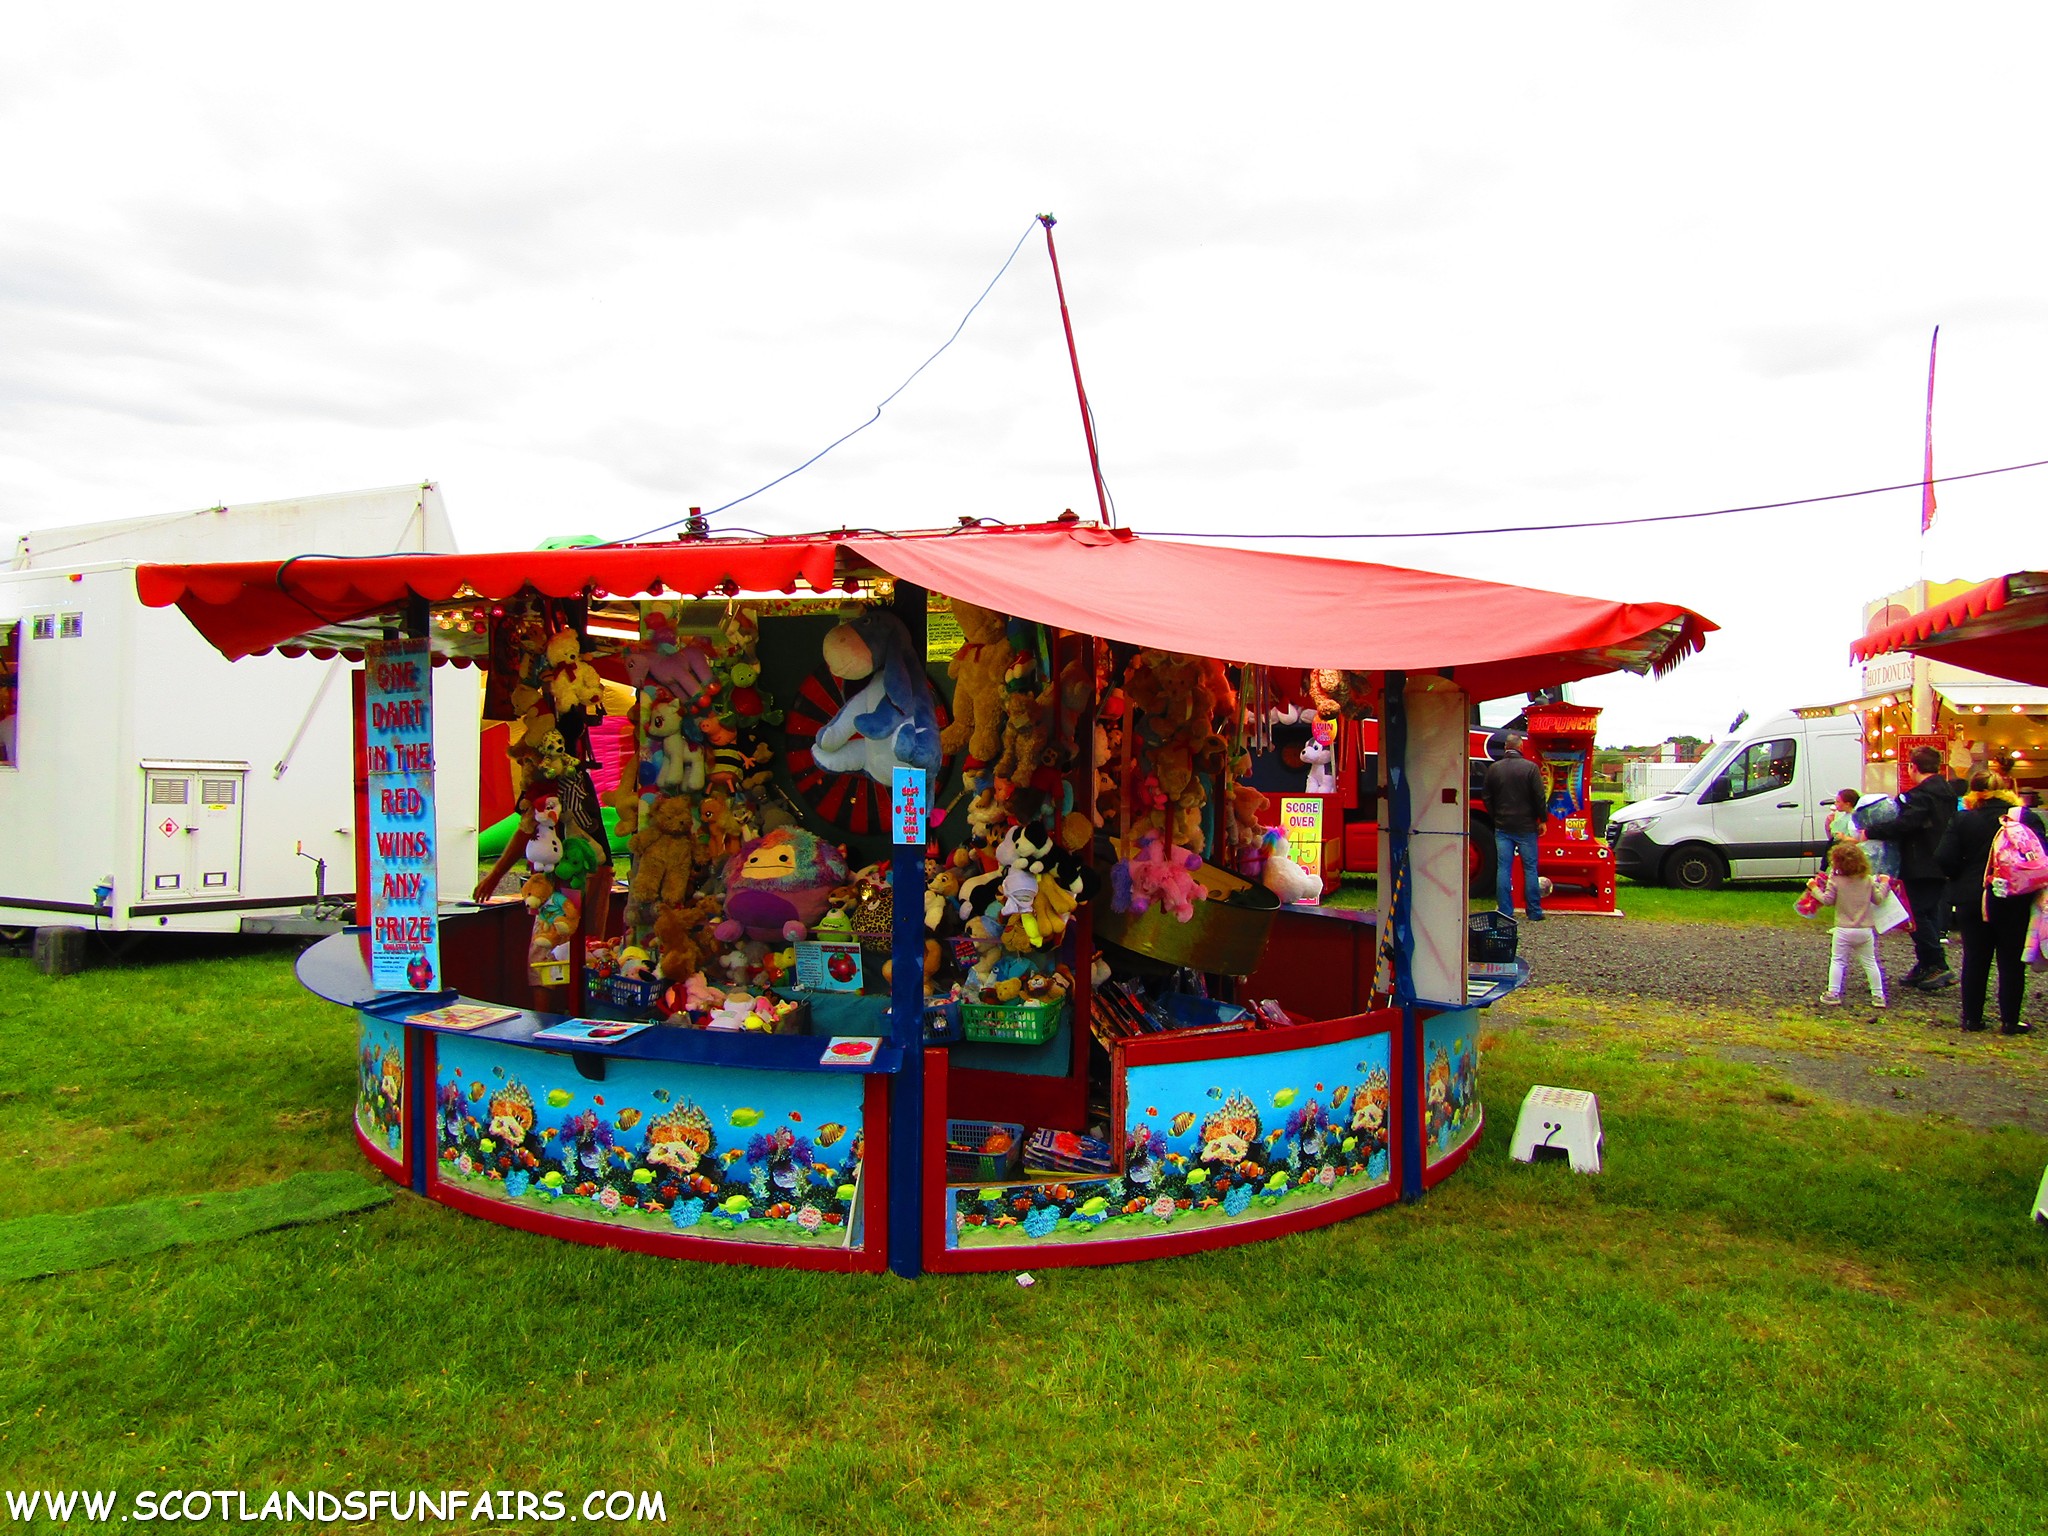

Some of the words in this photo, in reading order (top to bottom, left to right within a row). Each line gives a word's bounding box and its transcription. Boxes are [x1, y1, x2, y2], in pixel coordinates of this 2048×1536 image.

[377, 660, 415, 690] ONE
[1867, 668, 1882, 686] HOT
[1883, 661, 1911, 683] DONUTS
[372, 698, 424, 730] DART
[1316, 723, 1333, 731] WIN
[367, 744, 389, 771] IN
[393, 742, 431, 770] THE
[381, 788, 421, 815] RED
[1285, 802, 1319, 813] SCORE
[1289, 816, 1315, 827] OVER
[1567, 819, 1587, 829] ONLY
[376, 831, 428, 859] WINS
[381, 873, 421, 900] ANY
[375, 916, 433, 943] PRIZE
